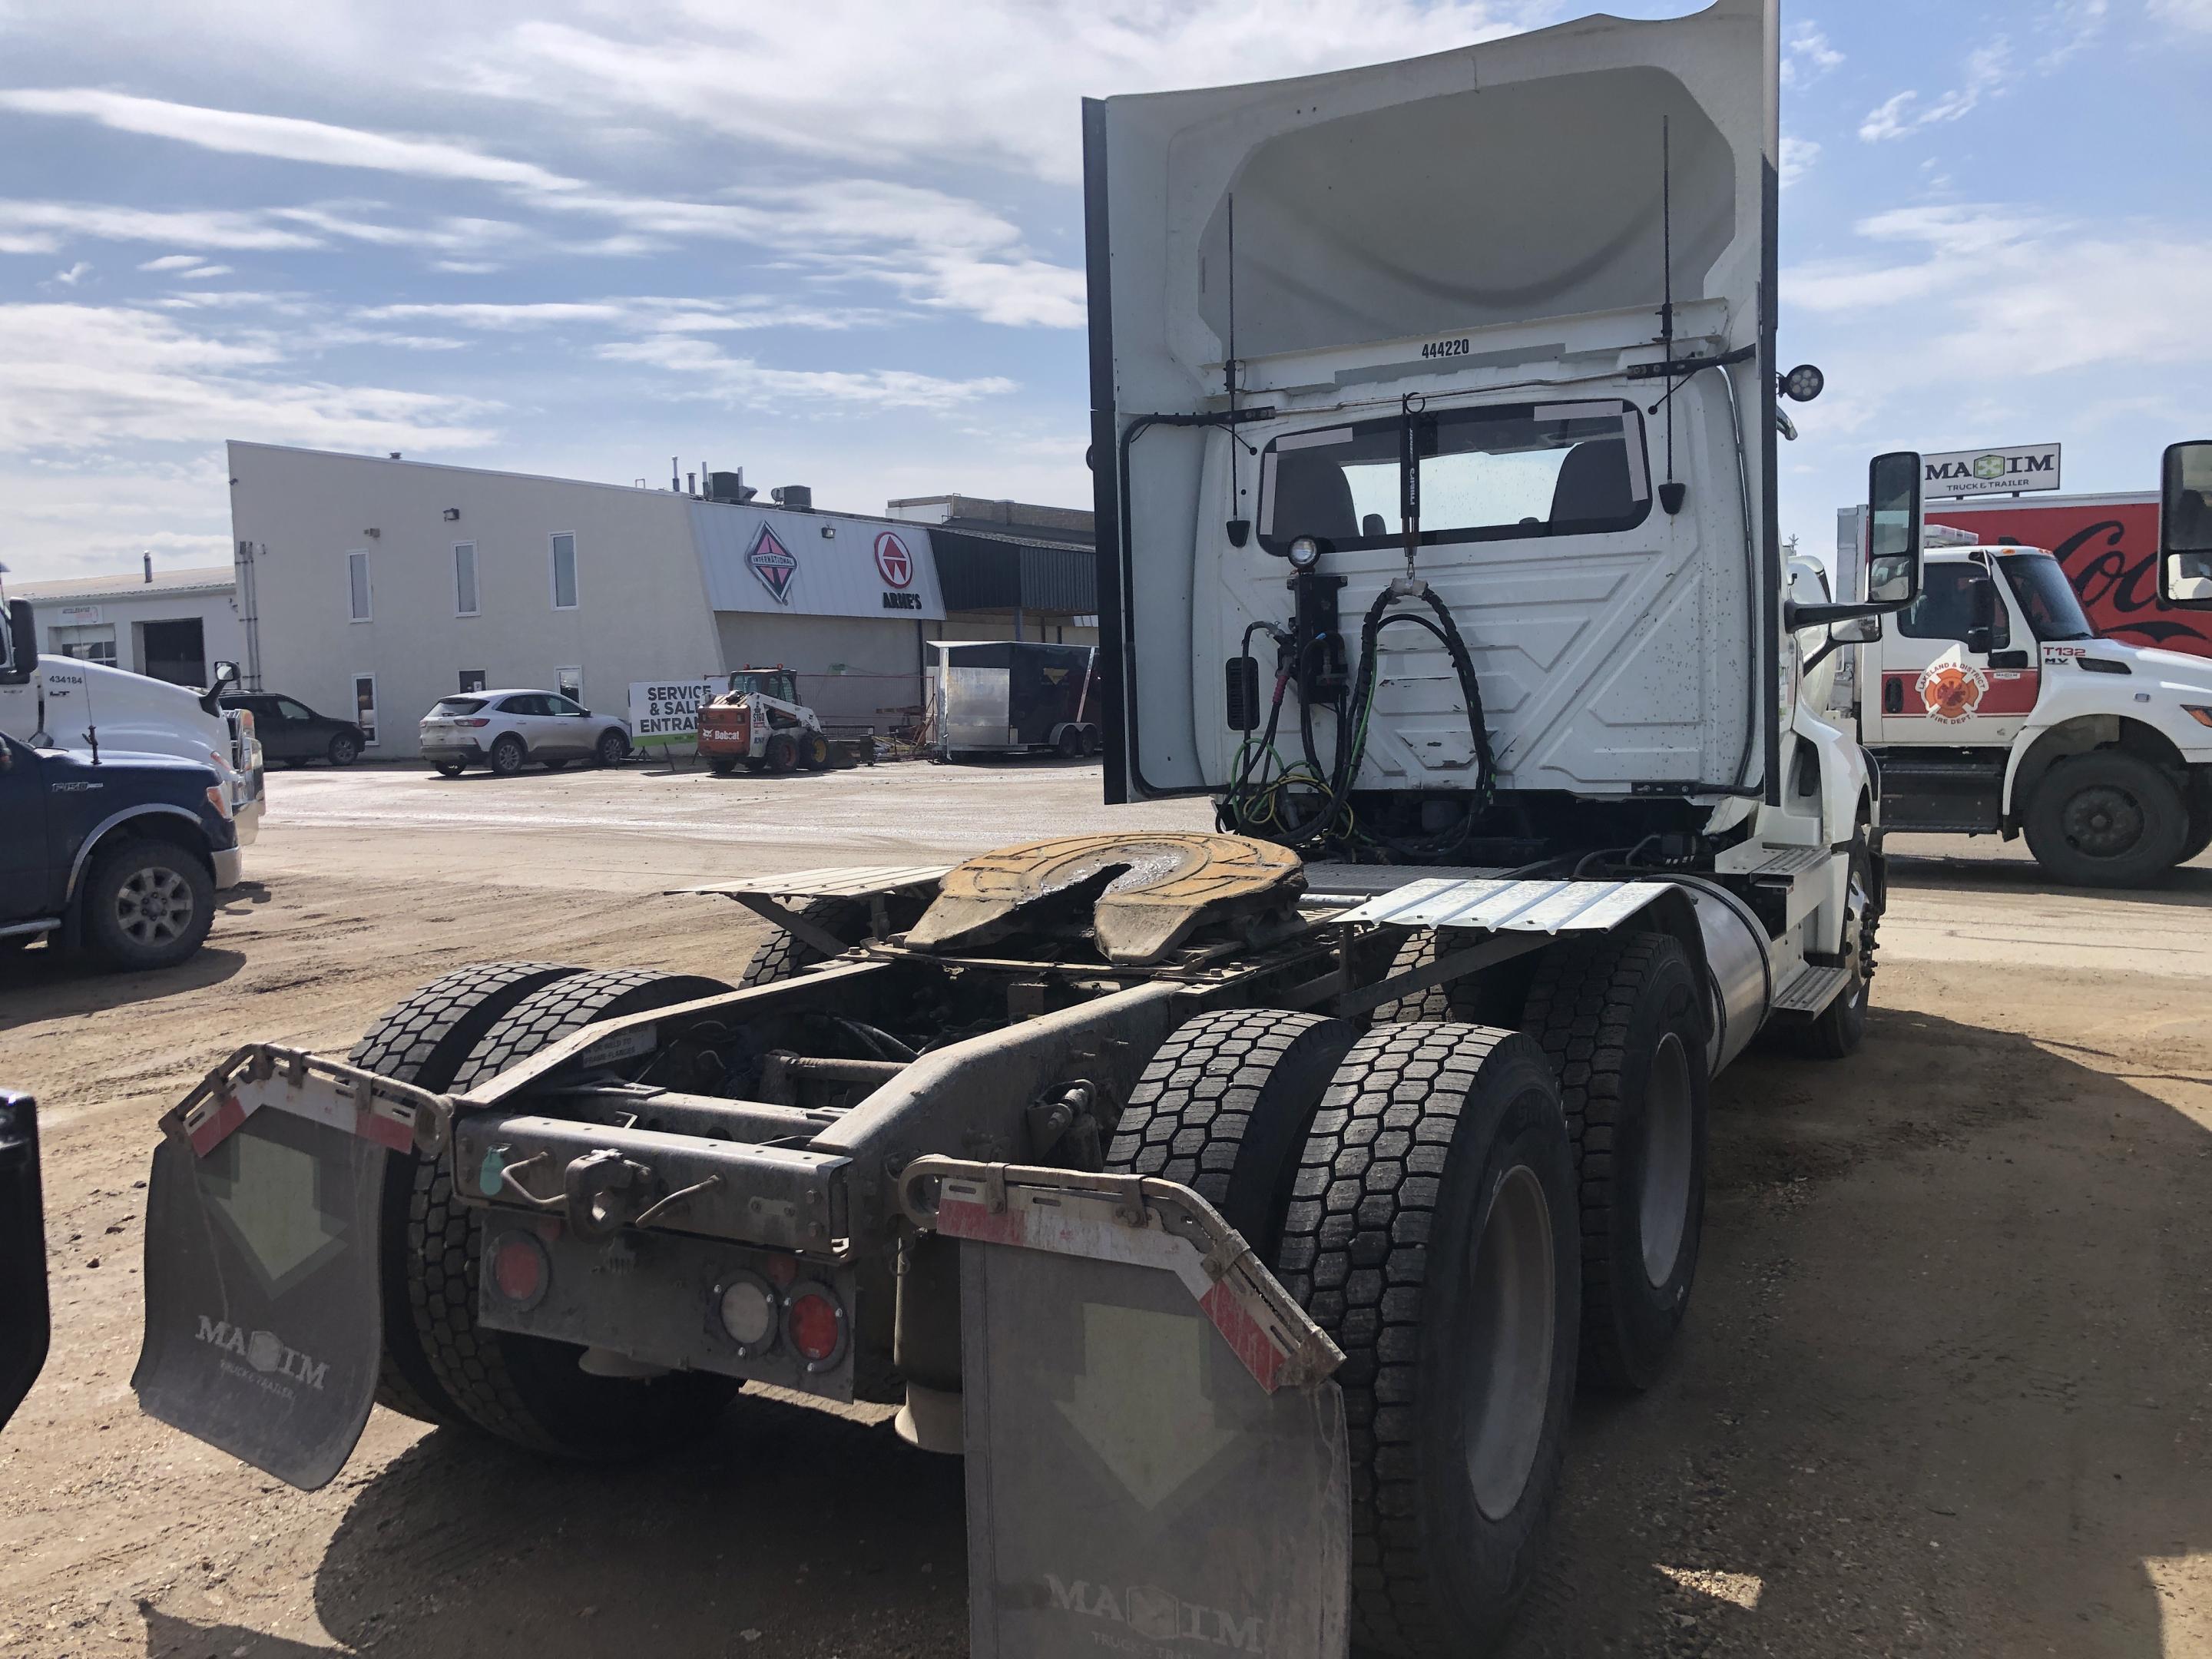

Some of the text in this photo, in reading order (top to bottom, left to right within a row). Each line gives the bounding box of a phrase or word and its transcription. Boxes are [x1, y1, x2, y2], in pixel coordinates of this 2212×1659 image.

[1421, 338, 1469, 359] 444220
[1925, 454, 2055, 481] MAXIM
[1946, 483, 1979, 492] TRUCK
[1988, 478, 2030, 488] TRAILER
[753, 555, 793, 565] INTERNATIONAL
[882, 592, 922, 609] ARNE'S
[2043, 647, 2086, 657] T132
[49, 675, 83, 684] 434184
[1919, 662, 1950, 690] LAKELAND
[1959, 663, 1986, 689] DISTRICT
[650, 700, 700, 716] & SALE
[1930, 714, 1949, 724] FIRE
[714, 730, 740, 740] Bobcat
[195, 1314, 331, 1391] MAIM
[1042, 1572, 1265, 1654] MAIM
